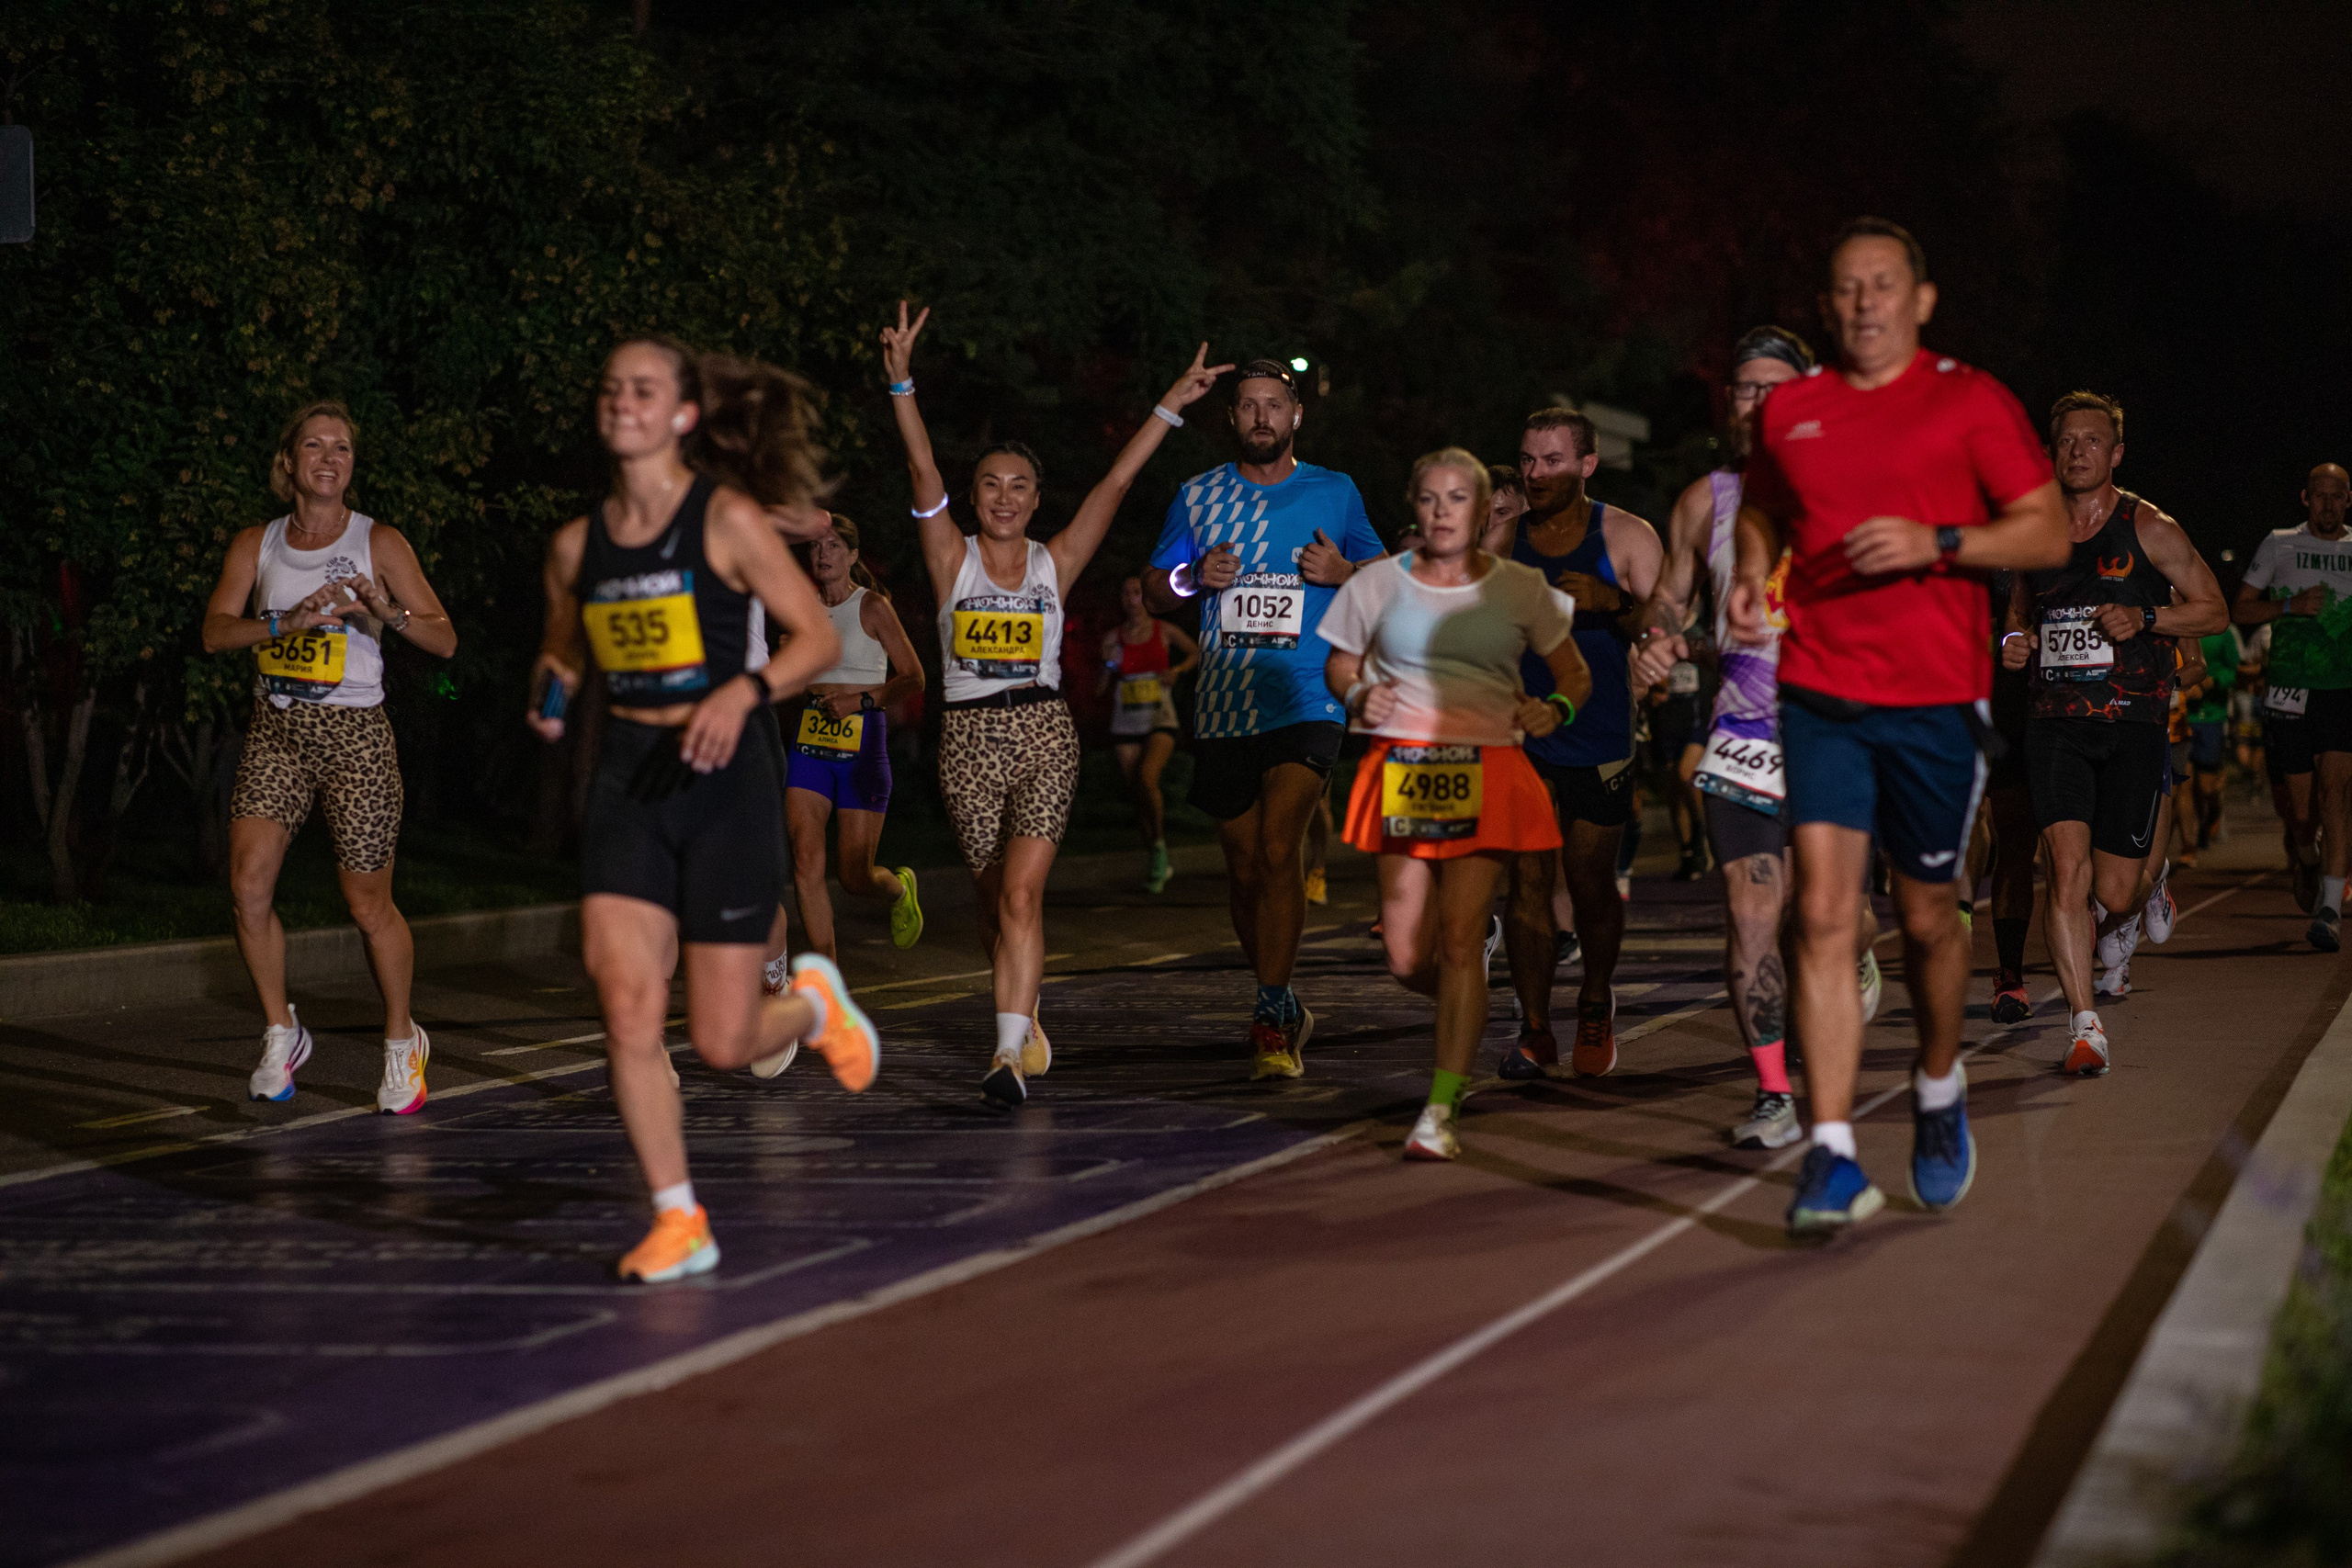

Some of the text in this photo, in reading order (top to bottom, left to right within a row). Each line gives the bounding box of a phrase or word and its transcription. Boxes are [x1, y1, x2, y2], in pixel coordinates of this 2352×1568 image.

[1234, 594, 1293, 618] 1052
[608, 609, 669, 647] 535
[966, 619, 1032, 644] 4413
[2048, 628, 2101, 652] 5785
[270, 637, 331, 665] 5651
[970, 646, 1024, 654] АЛЕКСАНДРА
[2057, 652, 2089, 661] АЛЕКСЕЙ
[284, 663, 312, 672] МАРИЯ
[808, 716, 853, 738] 3206
[1714, 739, 1782, 774] 4469
[1398, 773, 1469, 800] 4988
